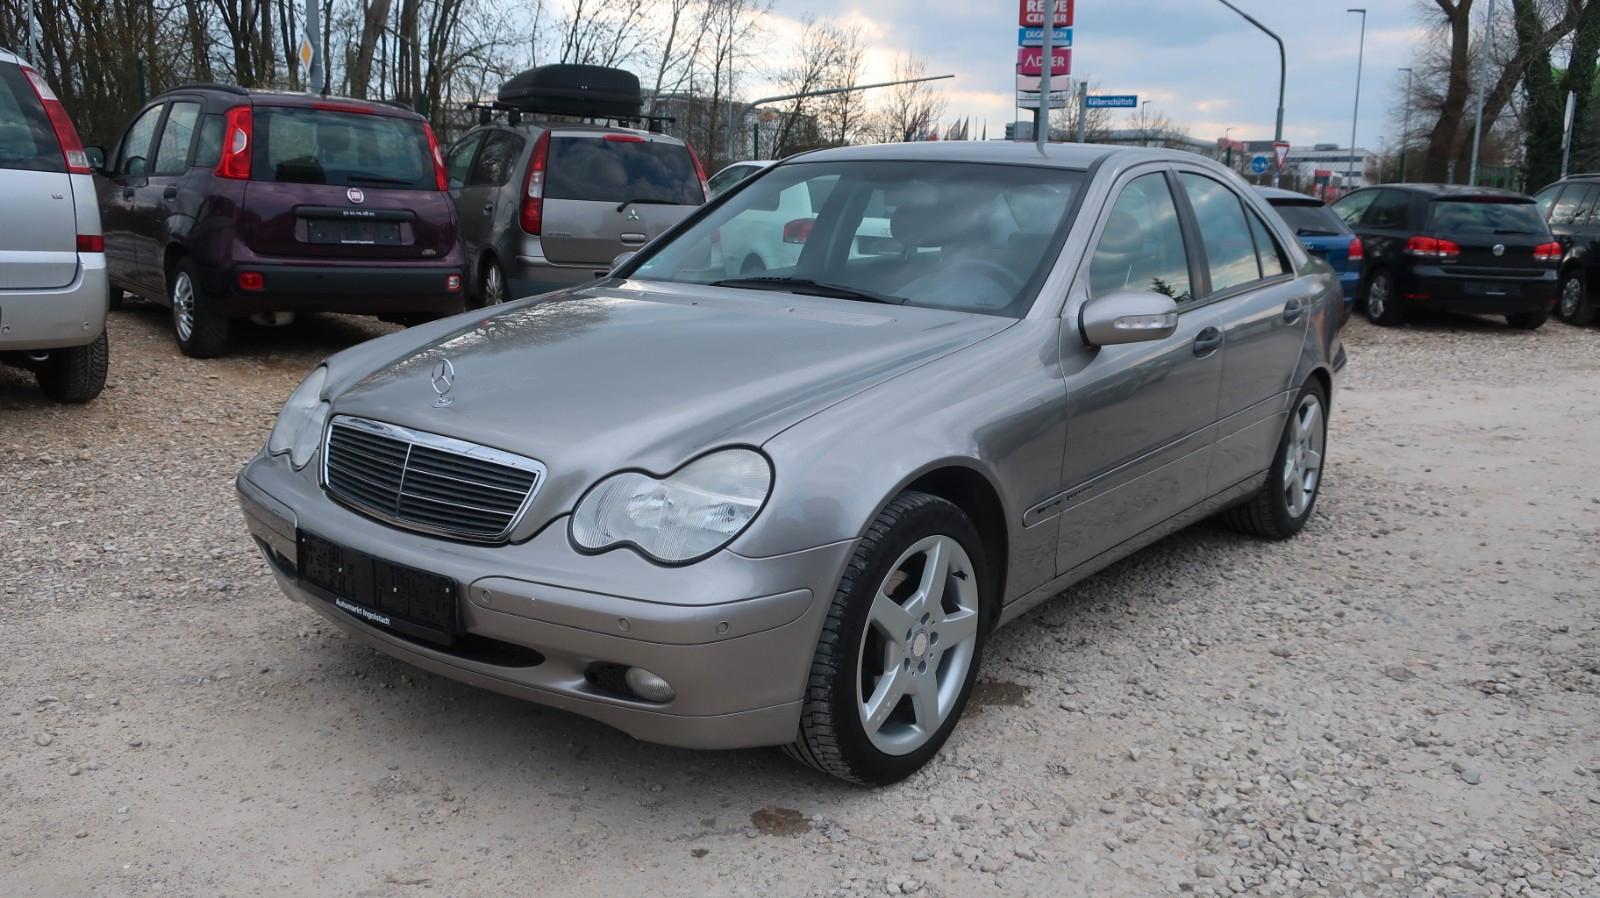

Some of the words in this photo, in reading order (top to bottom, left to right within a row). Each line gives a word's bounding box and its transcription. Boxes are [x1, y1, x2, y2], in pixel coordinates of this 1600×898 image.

[1024, 54, 1065, 67] ADER
[336, 598, 362, 614] Automarkt
[363, 609, 390, 624] Ingolstadt
